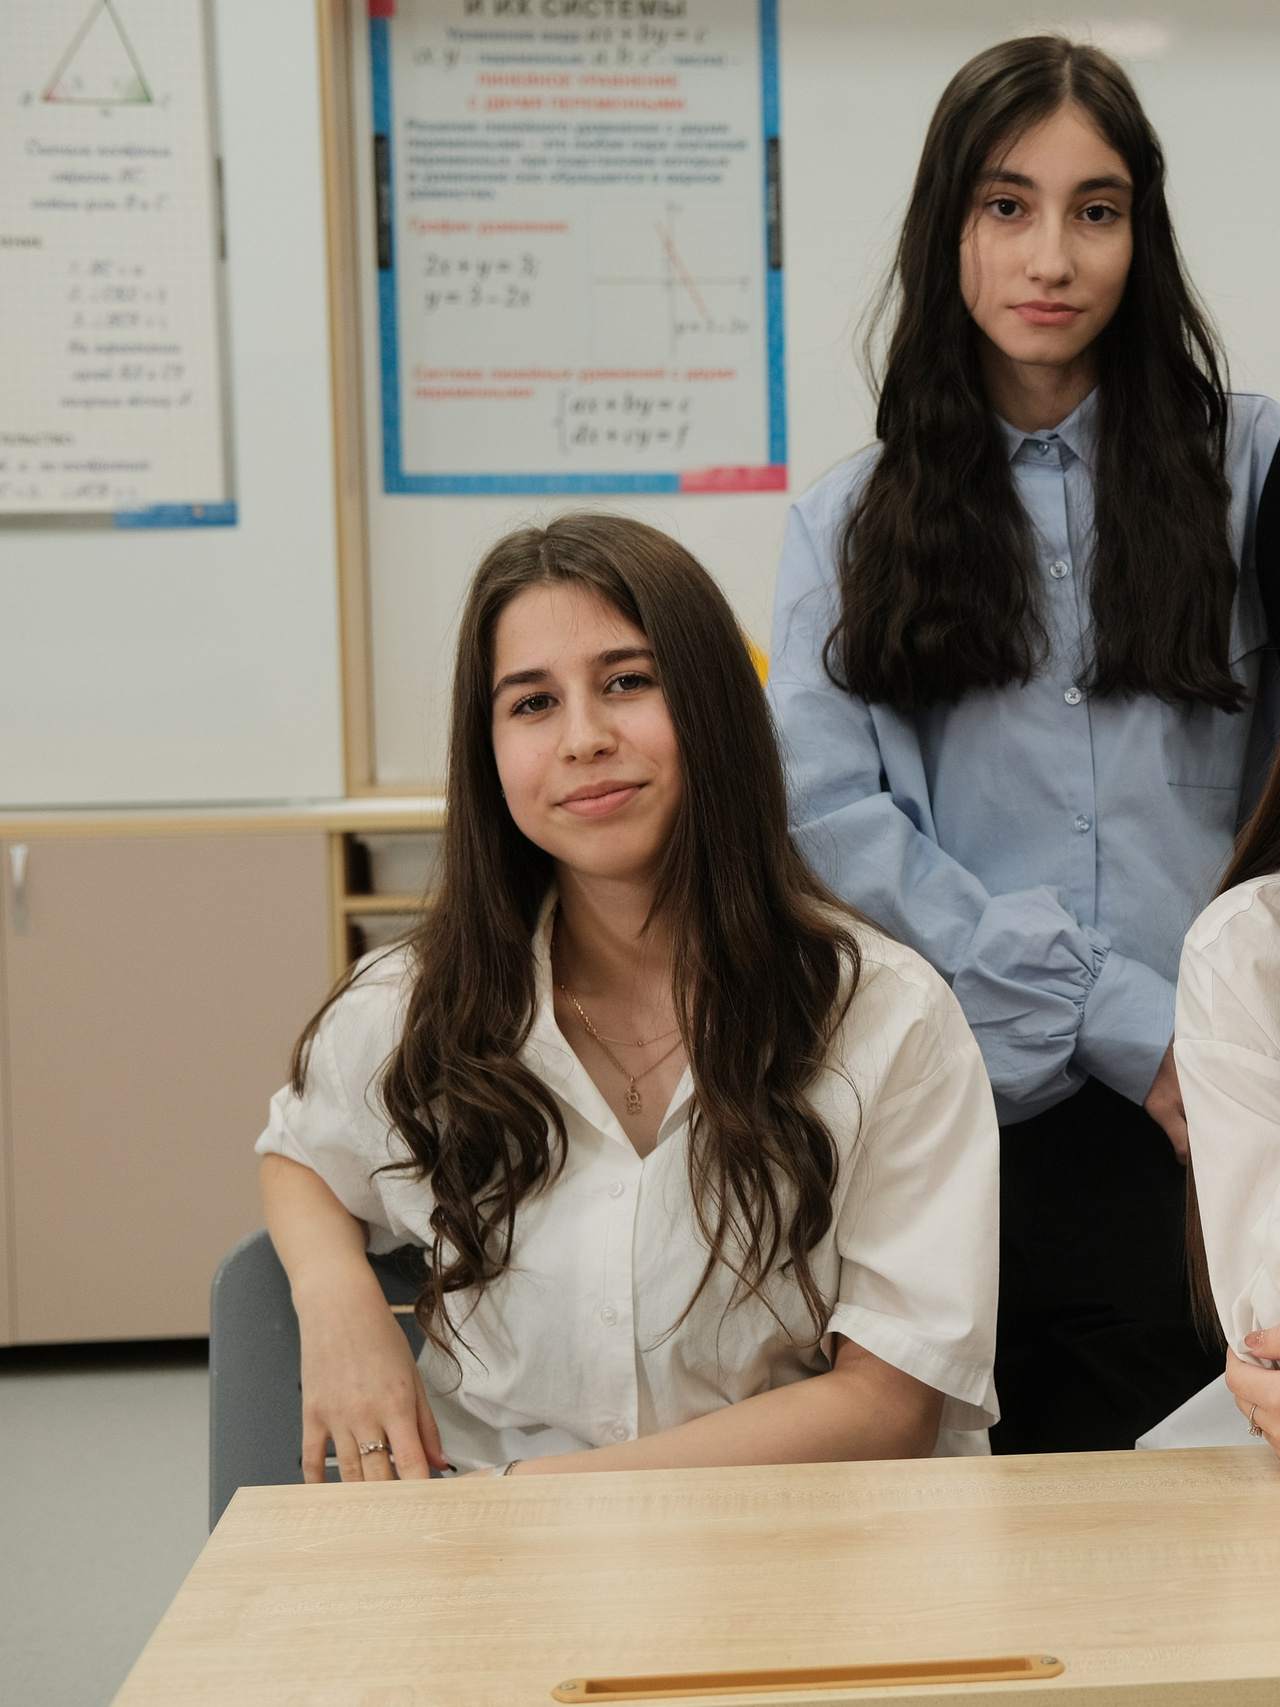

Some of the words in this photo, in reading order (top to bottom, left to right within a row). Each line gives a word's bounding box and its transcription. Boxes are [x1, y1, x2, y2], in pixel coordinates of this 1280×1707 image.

[494, 0, 529, 17] ИХ
[542, 0, 685, 17] СИСТЕМЫ
[478, 73, 572, 87] ЛИНЕЙНОЕ
[580, 73, 679, 87] УРАВНЕНИЕ
[485, 97, 545, 111] ДВУМЯ
[549, 97, 686, 111] ПЕРЕМЕННЫМИ
